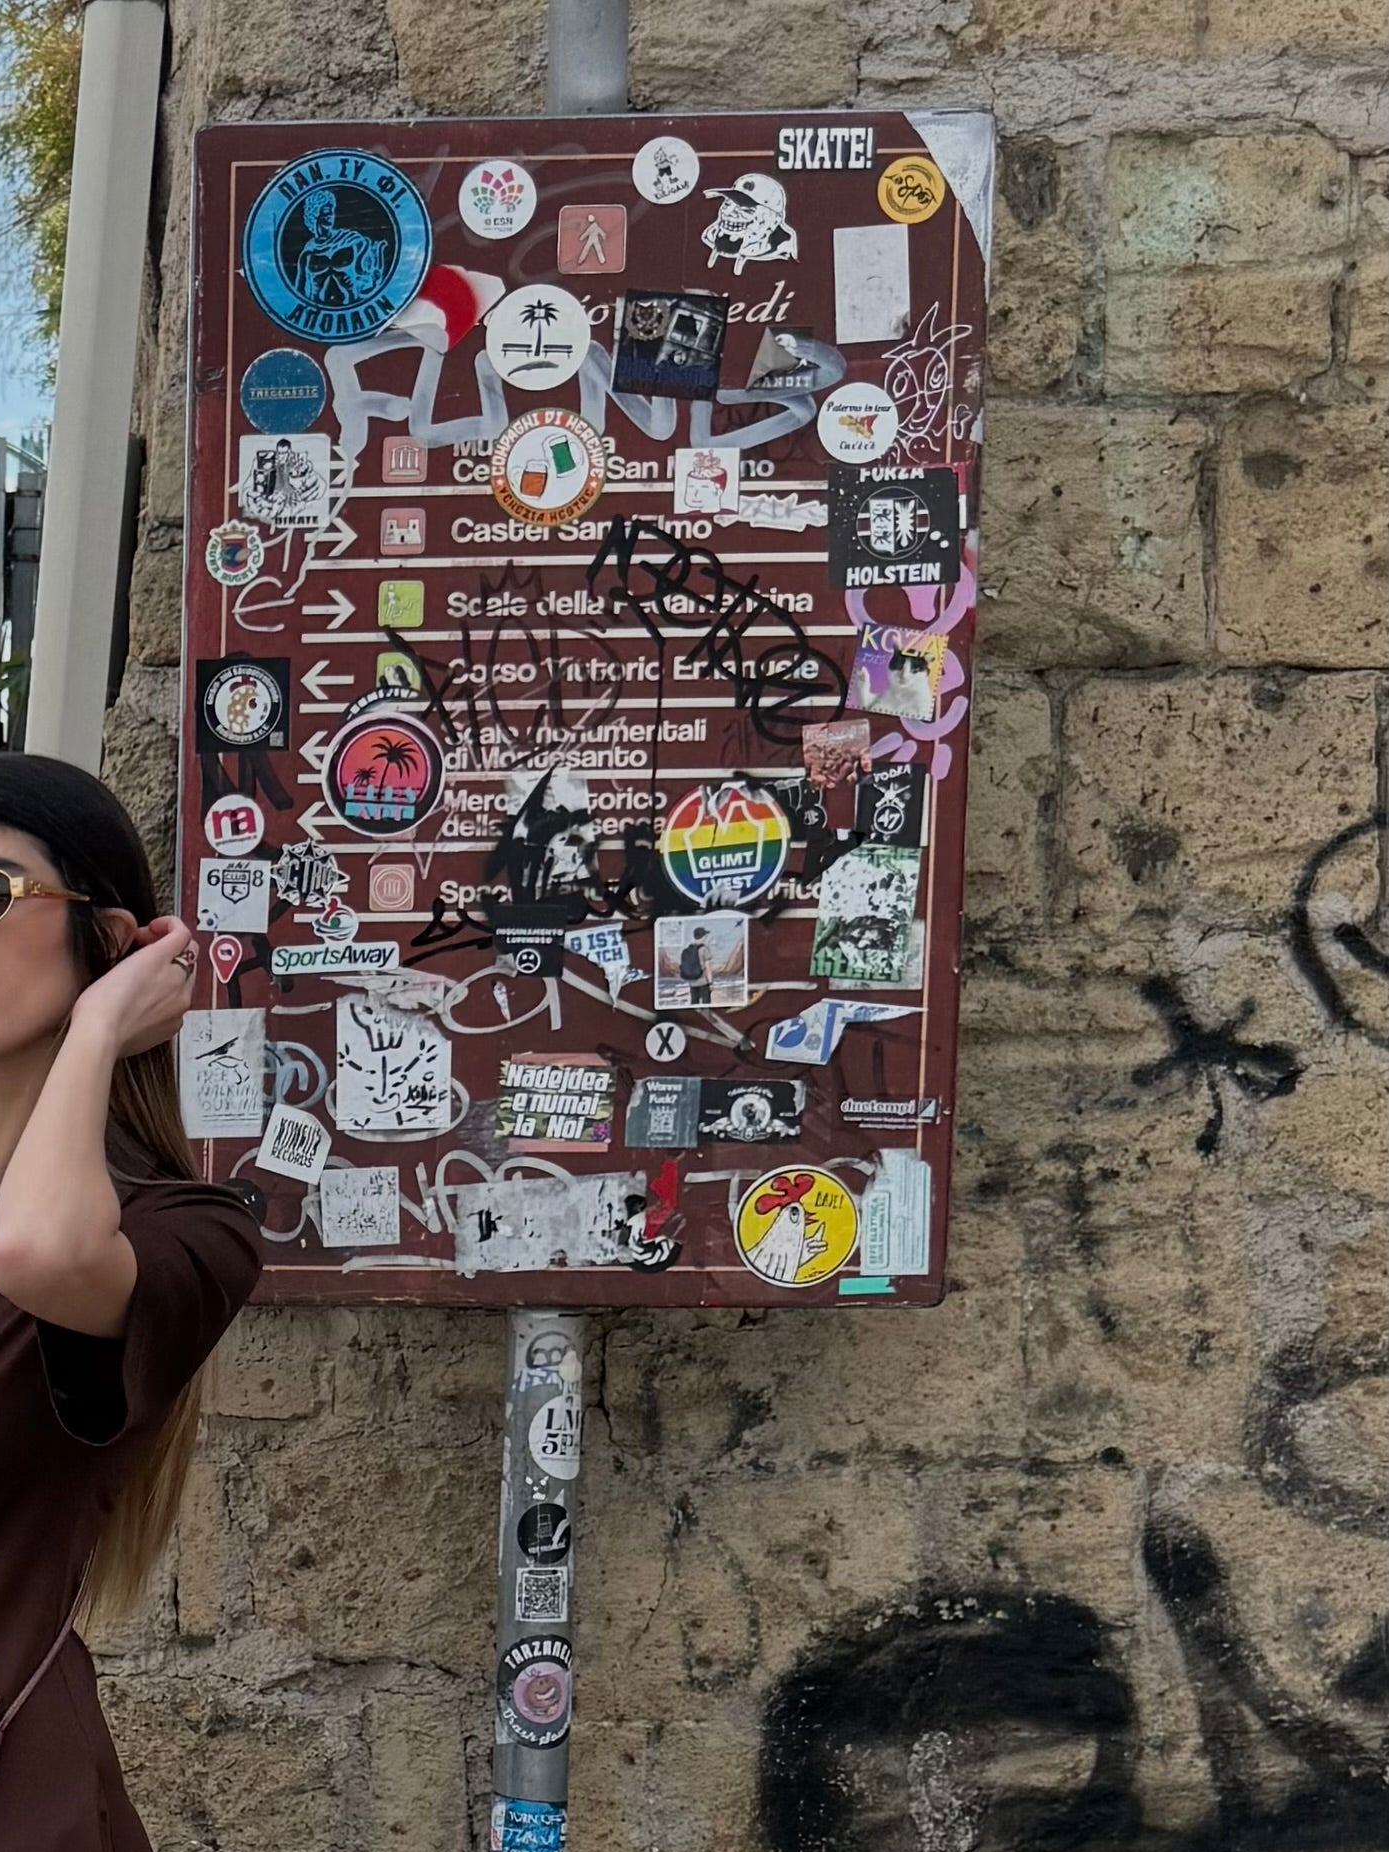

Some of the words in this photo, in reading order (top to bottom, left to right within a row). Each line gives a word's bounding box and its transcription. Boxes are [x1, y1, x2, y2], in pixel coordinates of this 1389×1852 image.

[778, 128, 873, 170] SKATE!
[491, 413, 540, 477] COMPAGNI
[544, 410, 561, 425] DI
[564, 413, 604, 480] MERENDE
[606, 457, 658, 480] San
[500, 487, 545, 523] VENEZIA
[548, 487, 595, 522] MESTRE
[451, 516, 550, 544] Castel
[846, 562, 941, 587] HOLSTEIN
[446, 591, 529, 618] Scale
[536, 590, 605, 617] della
[862, 624, 939, 658] KOZA
[448, 657, 537, 685] Corso
[444, 748, 468, 771] di
[873, 764, 912, 783] VODKA
[443, 789, 509, 812] Merc
[587, 787, 667, 811] torico
[441, 813, 504, 838] della
[876, 809, 902, 829] 47
[698, 850, 754, 870] GLIMT
[206, 868, 221, 887] 6
[252, 868, 264, 888] 8
[710, 873, 755, 891] VEST
[274, 945, 395, 972] SportsAway
[656, 1026, 674, 1057] X
[507, 1063, 612, 1093] Nadejdea
[512, 1094, 529, 1112] e
[529, 1093, 600, 1115] numai
[513, 1114, 535, 1137] la
[546, 1116, 585, 1139] Noi
[270, 1144, 315, 1169] RECORDS
